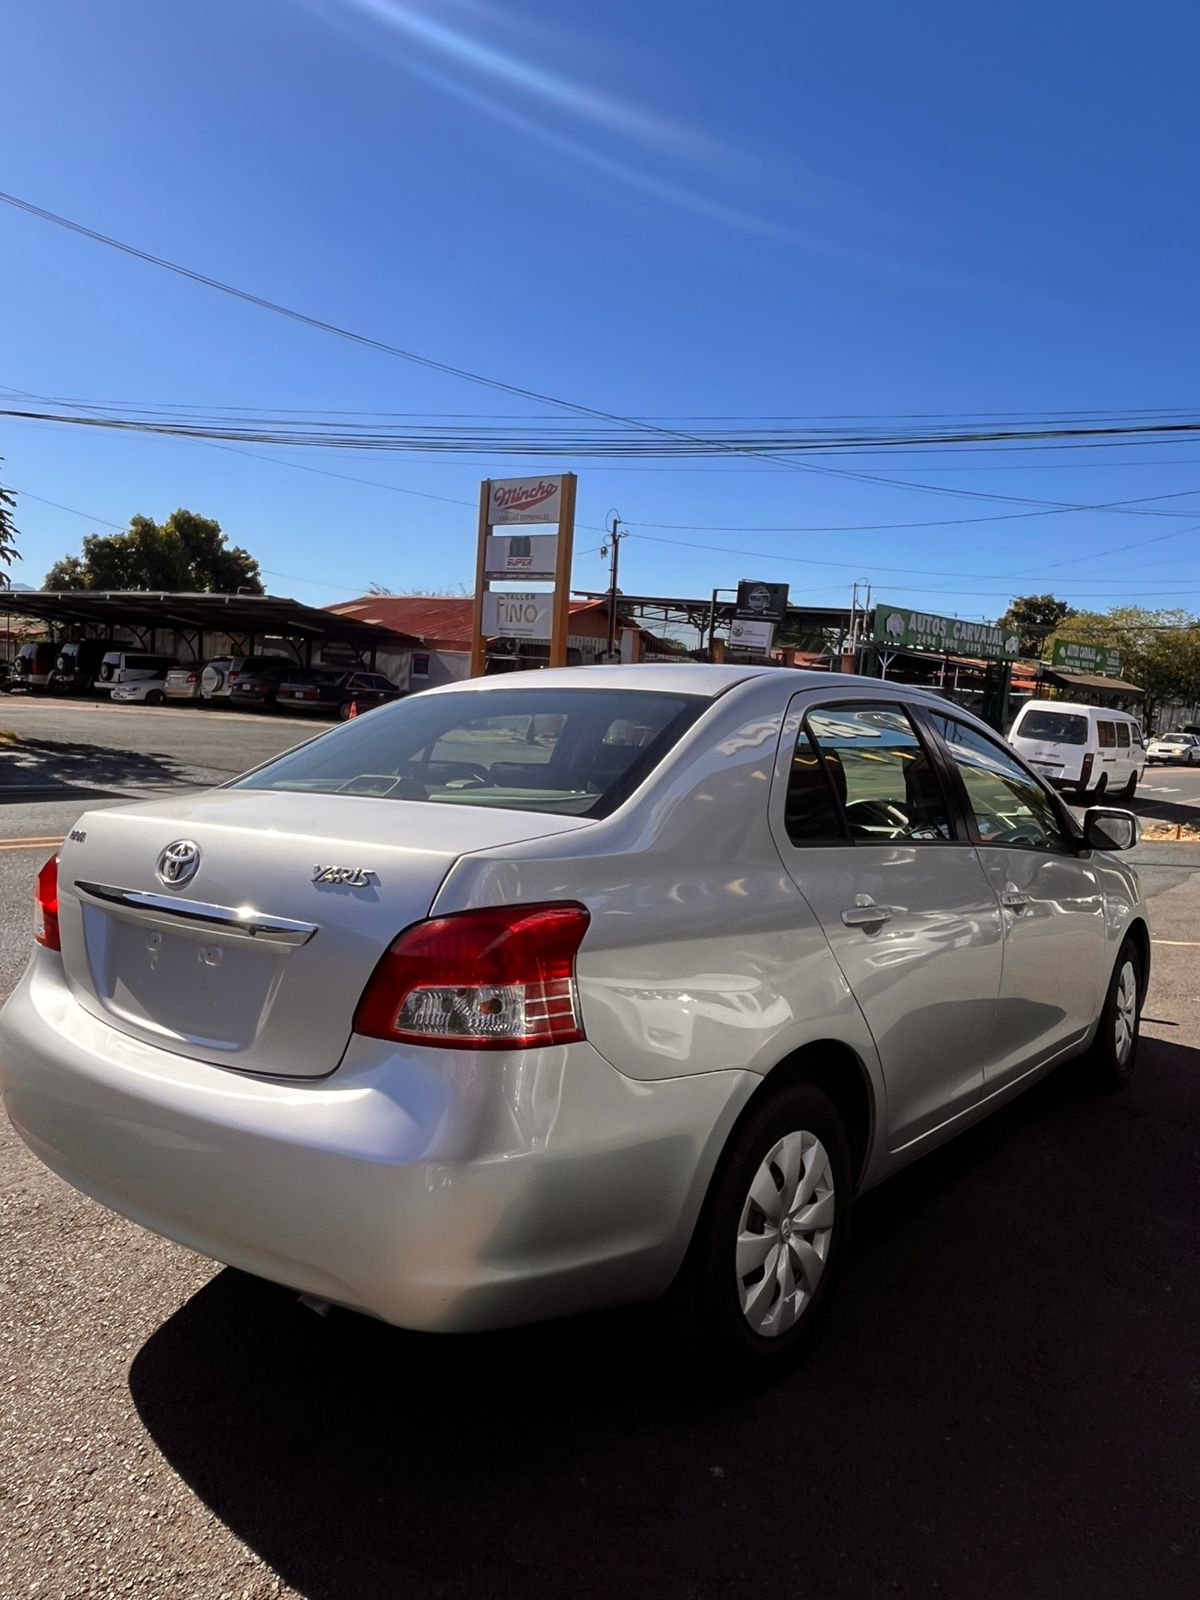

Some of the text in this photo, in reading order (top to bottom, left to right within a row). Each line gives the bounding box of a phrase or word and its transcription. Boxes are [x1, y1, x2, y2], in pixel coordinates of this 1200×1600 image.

[494, 480, 558, 507] Mincho
[507, 558, 533, 567] SUPER
[496, 595, 538, 625] FINO
[908, 613, 1004, 646] AUTOS CARVAJAL
[311, 864, 376, 888] YARIS
